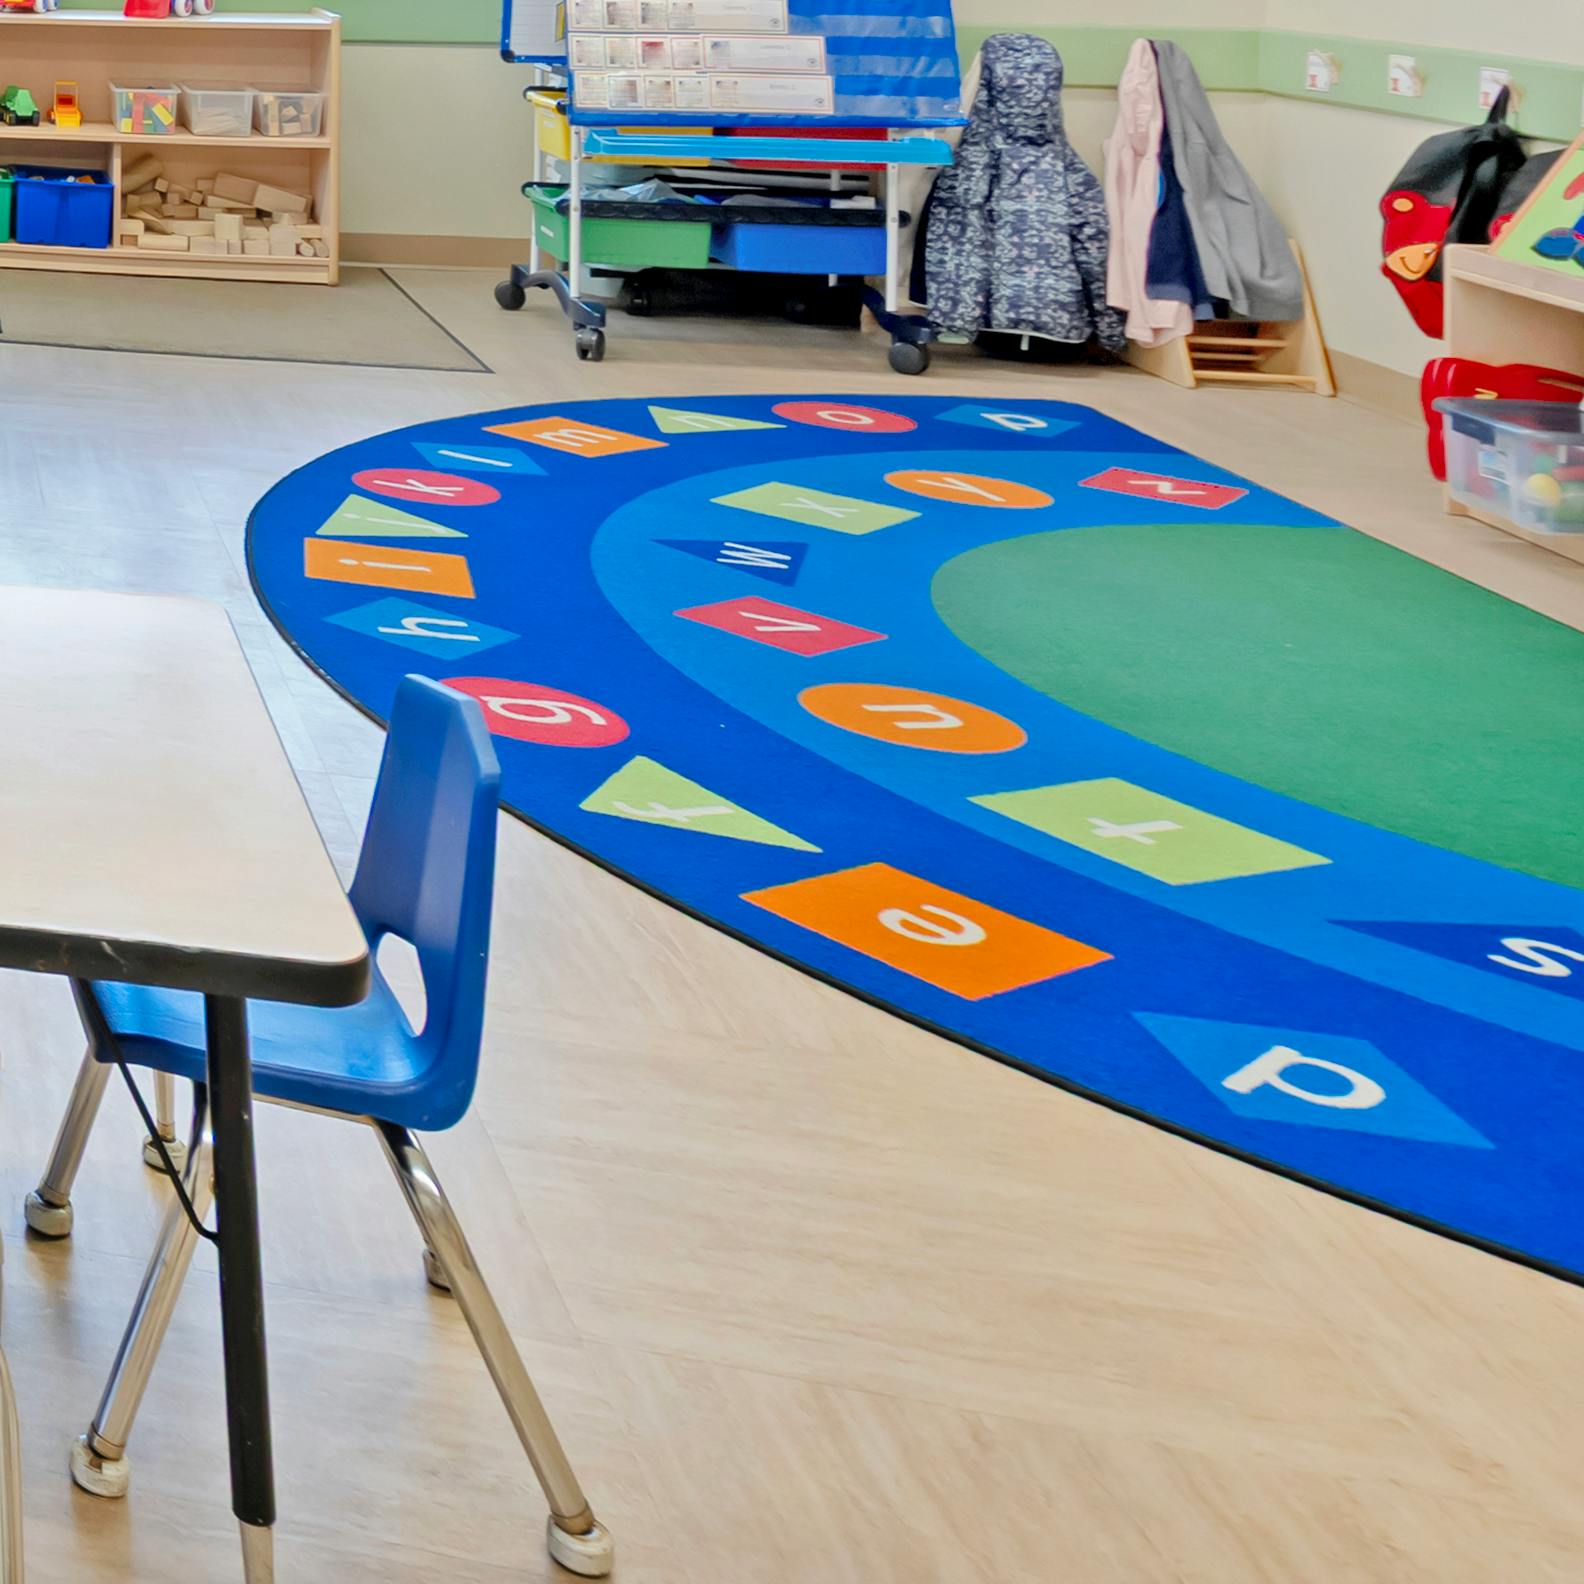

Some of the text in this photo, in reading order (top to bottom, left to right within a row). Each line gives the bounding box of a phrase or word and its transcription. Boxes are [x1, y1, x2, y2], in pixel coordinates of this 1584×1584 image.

[816, 410, 875, 425] o
[532, 428, 618, 447] m
[373, 478, 464, 497] k
[916, 476, 1007, 503] y
[781, 497, 859, 518] x
[342, 512, 450, 535] j
[377, 617, 481, 642] h
[739, 611, 822, 633] v
[500, 695, 608, 728] g
[611, 799, 736, 826] f
[1085, 816, 1184, 845] t
[877, 903, 988, 947] e
